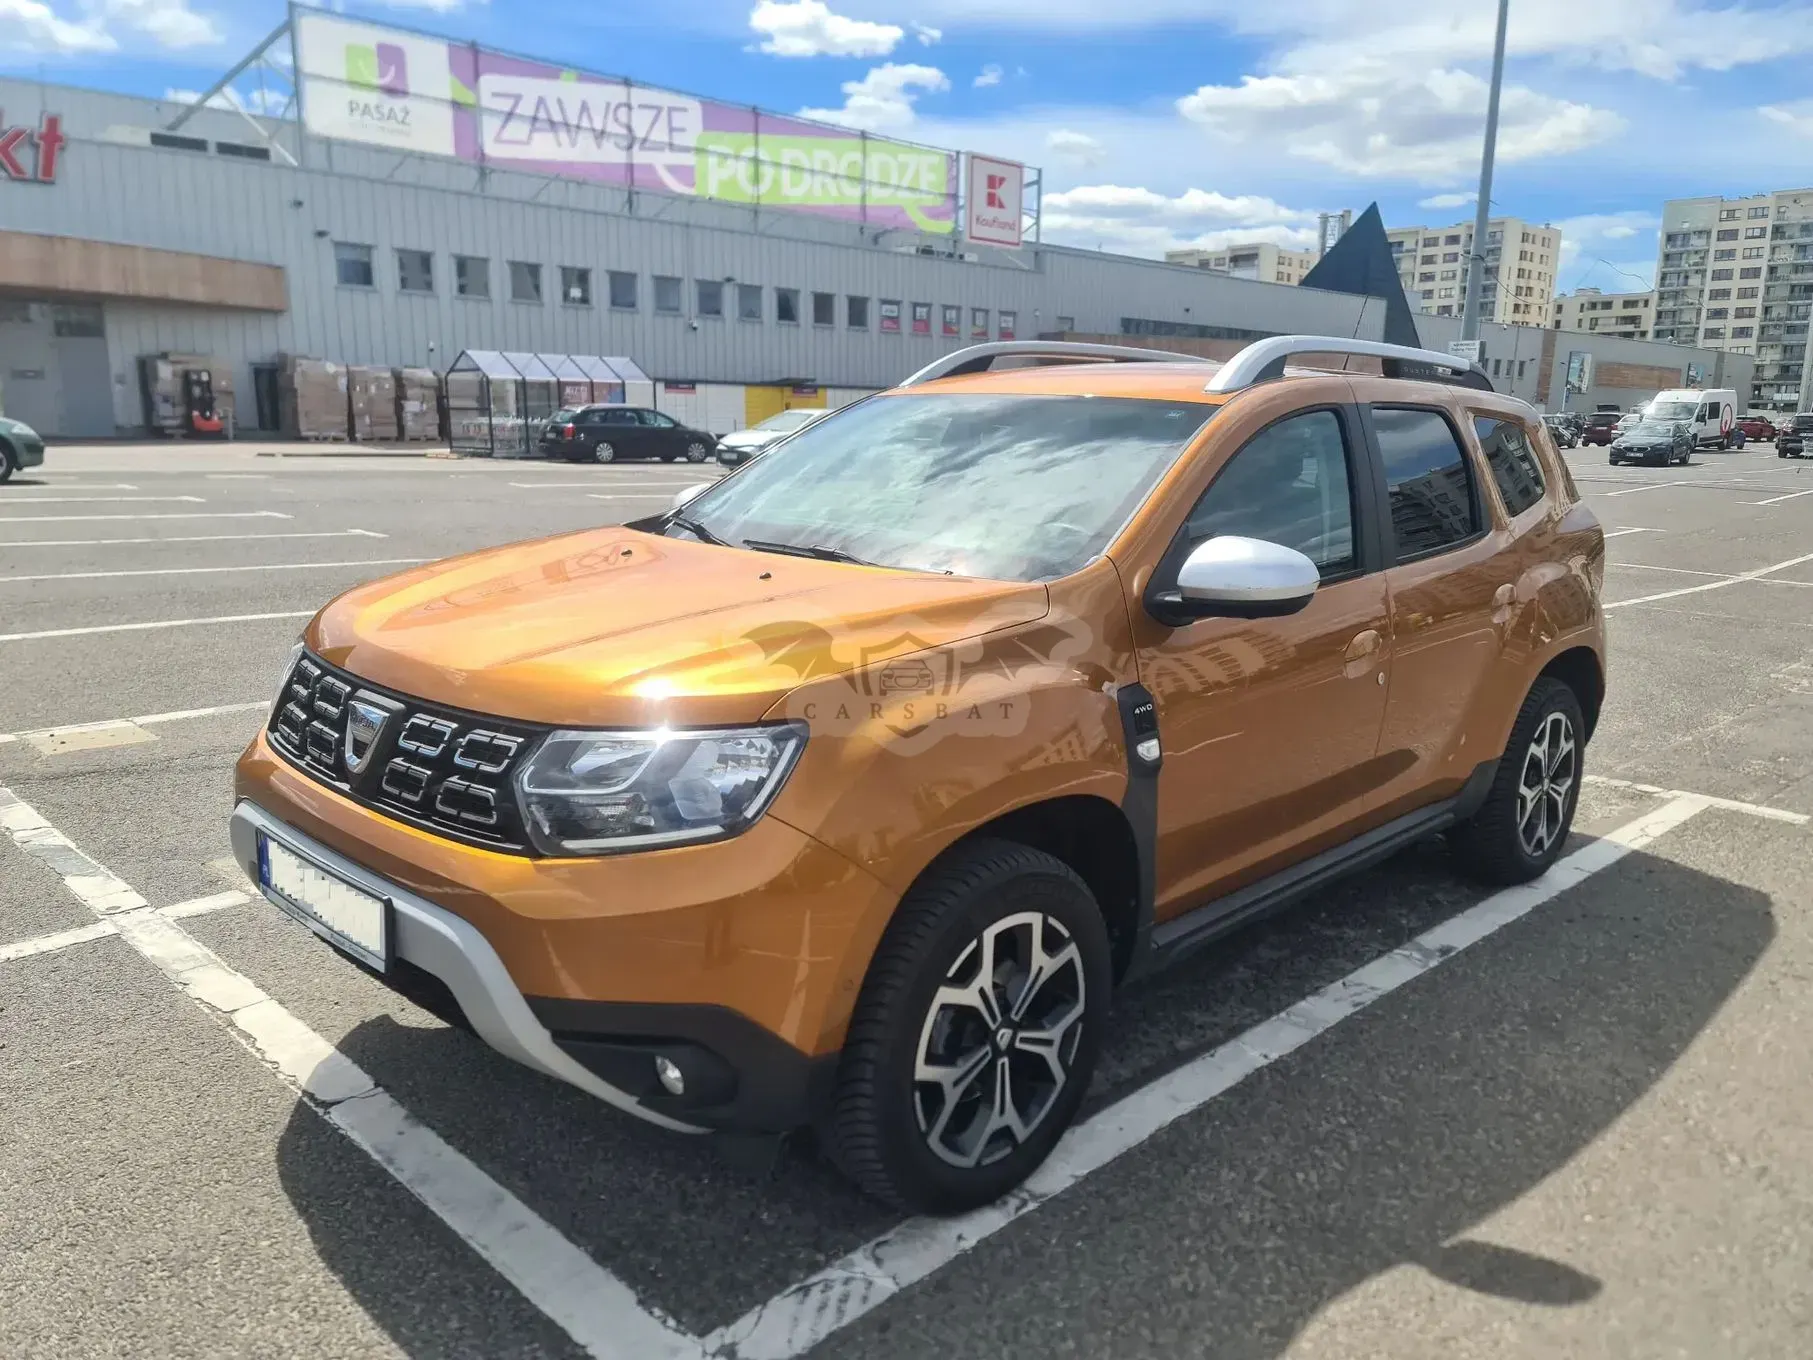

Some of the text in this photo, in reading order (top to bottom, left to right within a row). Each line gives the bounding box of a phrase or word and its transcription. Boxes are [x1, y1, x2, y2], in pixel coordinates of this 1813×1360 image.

[491, 92, 690, 154] ZAWSZE
[707, 143, 941, 200] PO DRODZE
[1134, 703, 1153, 715] 4WD
